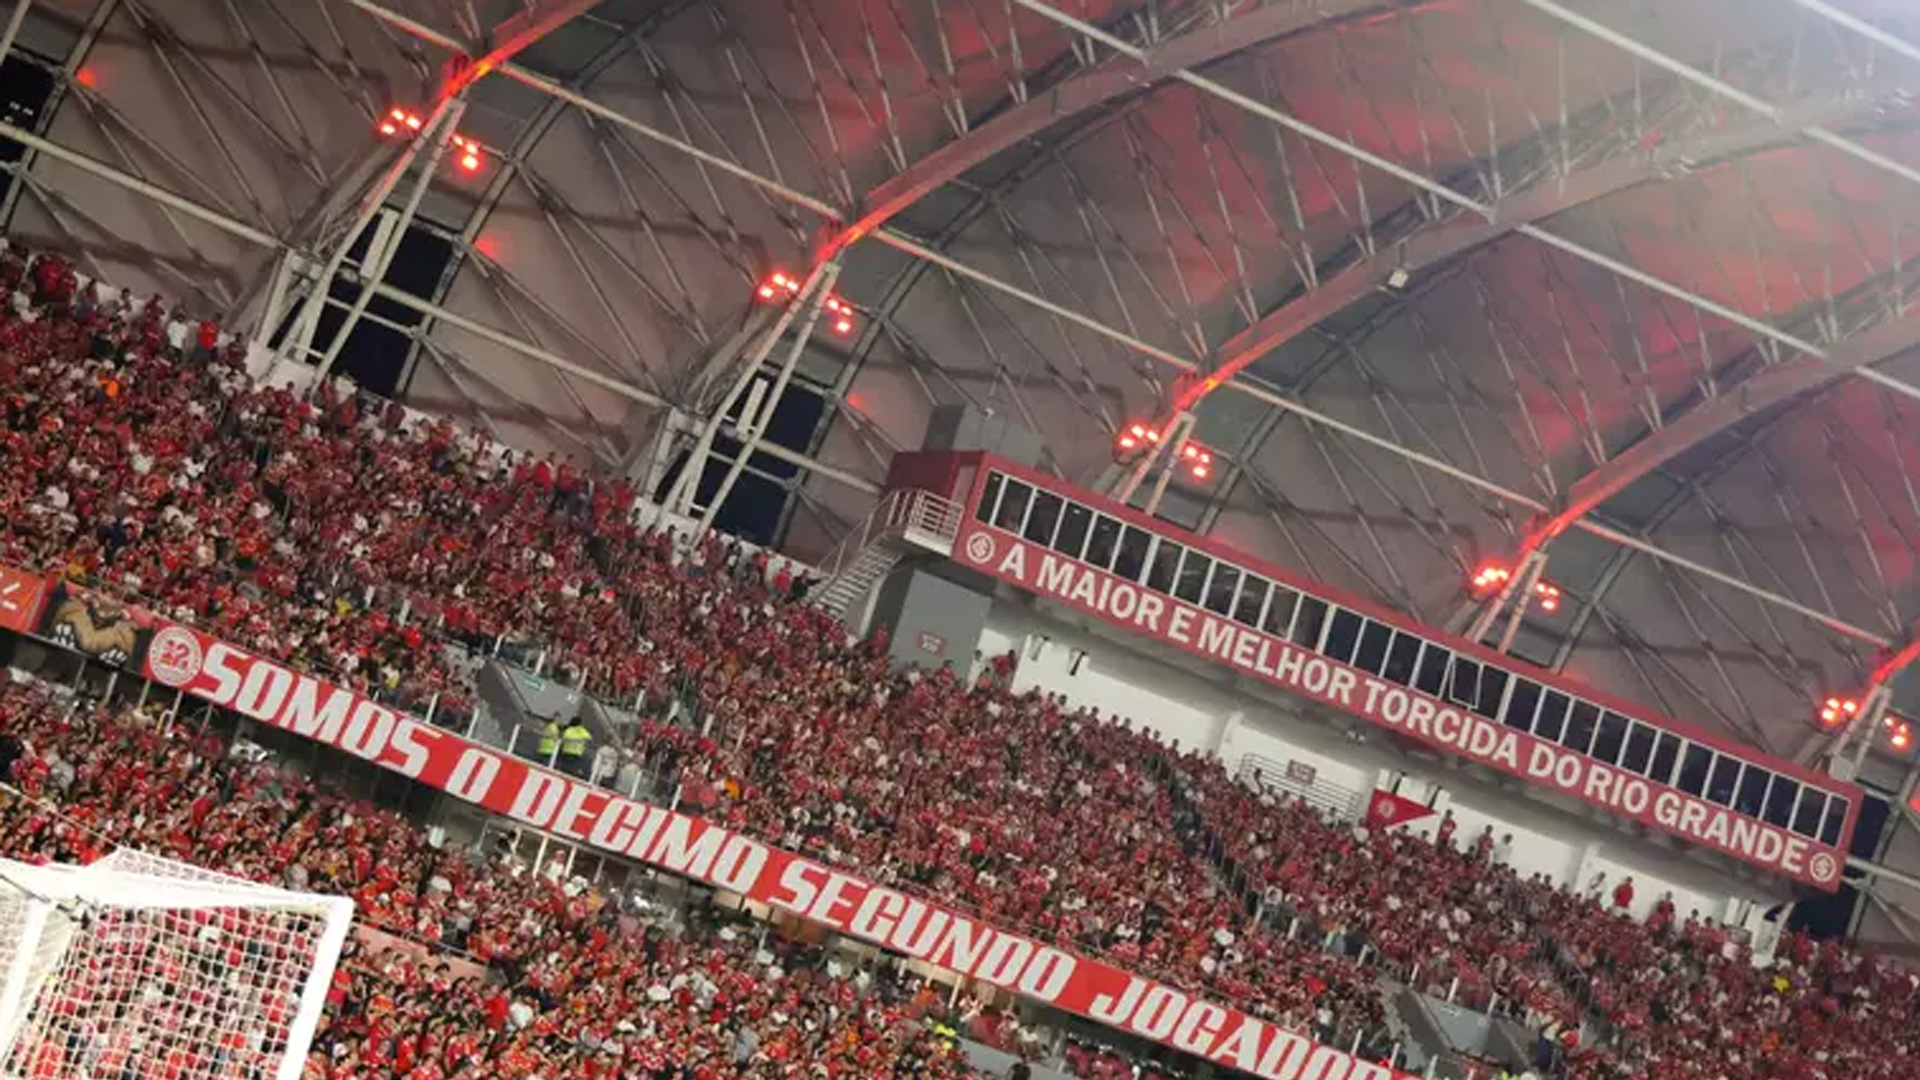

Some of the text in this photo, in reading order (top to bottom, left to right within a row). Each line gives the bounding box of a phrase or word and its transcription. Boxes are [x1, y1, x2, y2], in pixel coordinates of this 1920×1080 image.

[191, 642, 443, 779] SOMOS
[445, 748, 502, 803] O
[508, 768, 768, 895] DECIMO
[770, 856, 1077, 1002] SEGUNDO
[998, 544, 1809, 873] A MAIOR E MELHOR TORCIDA DO RIO GRANDE
